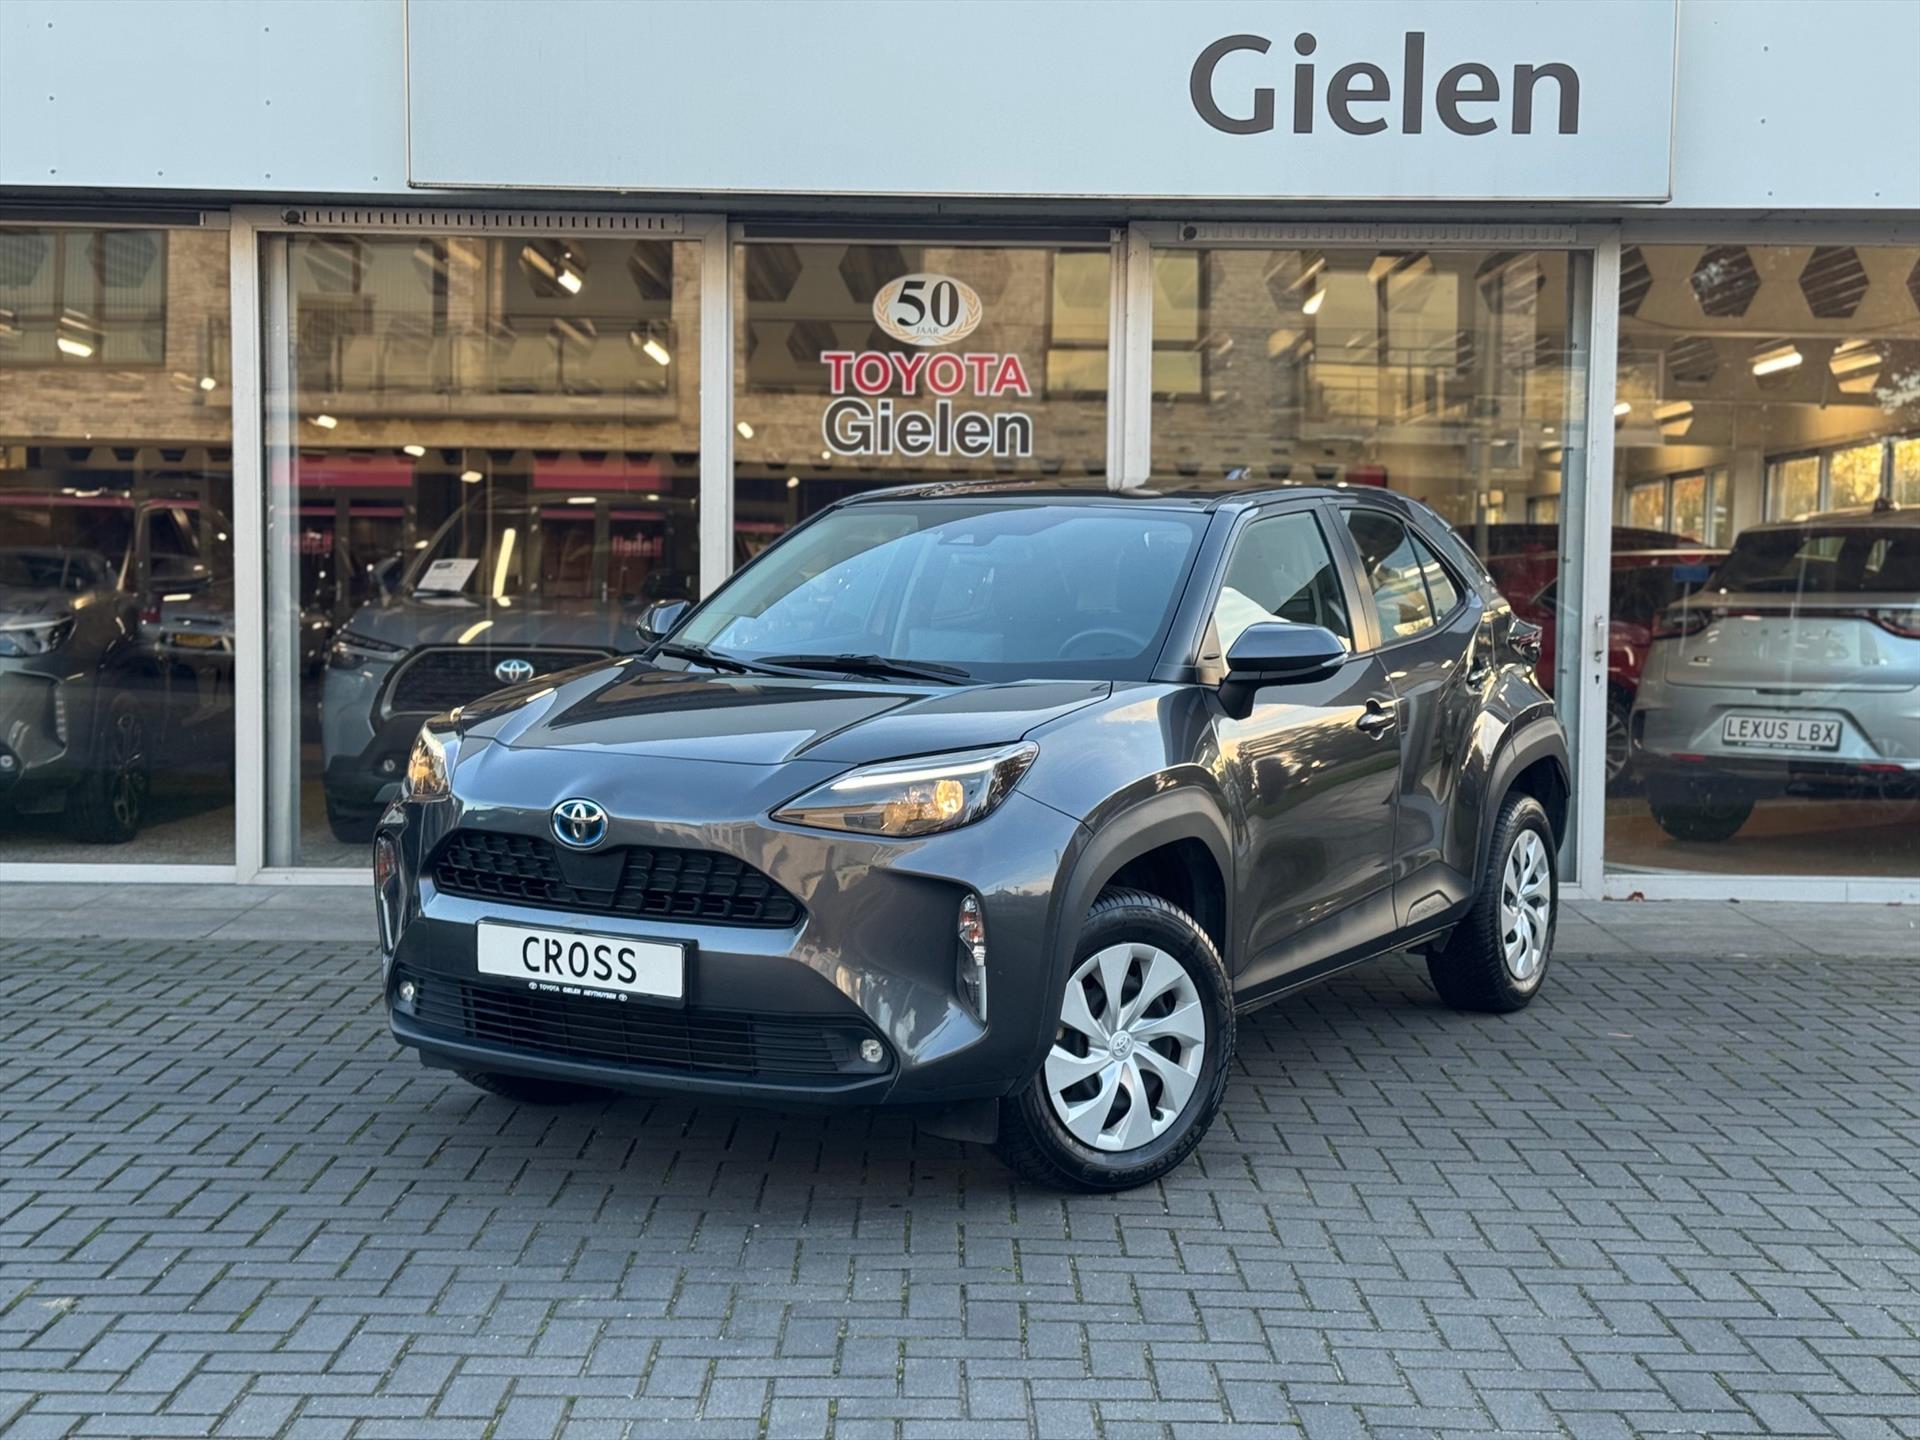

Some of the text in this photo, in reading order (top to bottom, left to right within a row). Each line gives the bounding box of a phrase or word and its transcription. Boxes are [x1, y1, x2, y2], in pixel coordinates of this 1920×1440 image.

[1189, 31, 1580, 136] Gielen
[897, 280, 959, 327] 50
[916, 326, 940, 335] JAAR
[821, 352, 1031, 397] TOYOTA
[823, 398, 1032, 457] Gielen
[1727, 720, 1834, 742] LEXUS LBX
[522, 936, 637, 984] CROSS
[540, 984, 560, 992] TOYOTA
